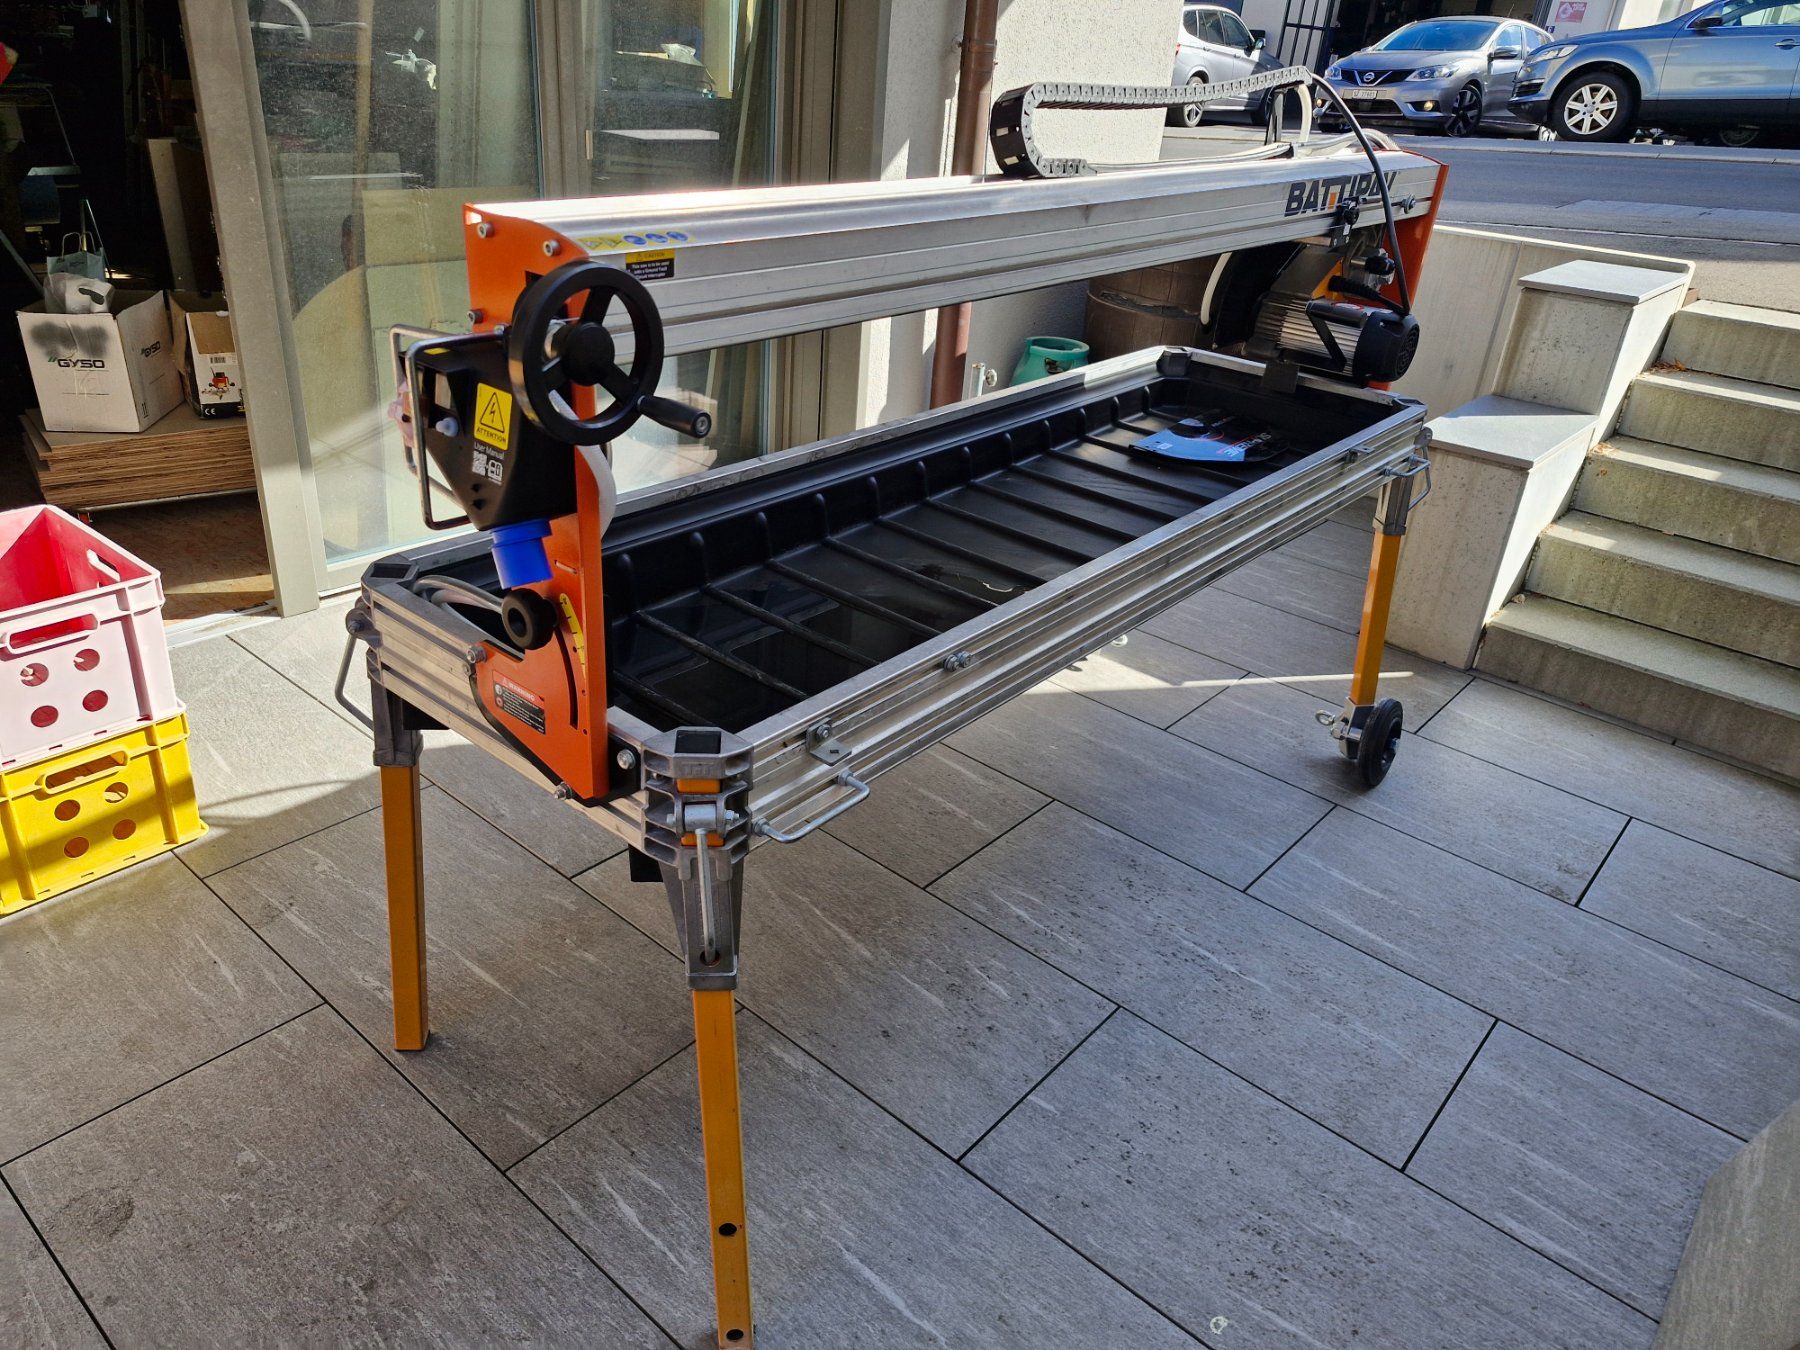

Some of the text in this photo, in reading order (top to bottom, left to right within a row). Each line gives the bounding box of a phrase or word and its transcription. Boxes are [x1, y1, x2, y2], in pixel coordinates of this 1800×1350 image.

[58, 358, 105, 369] GYSO
[476, 426, 506, 443] ATTENTION
[474, 441, 504, 460] User Manual
